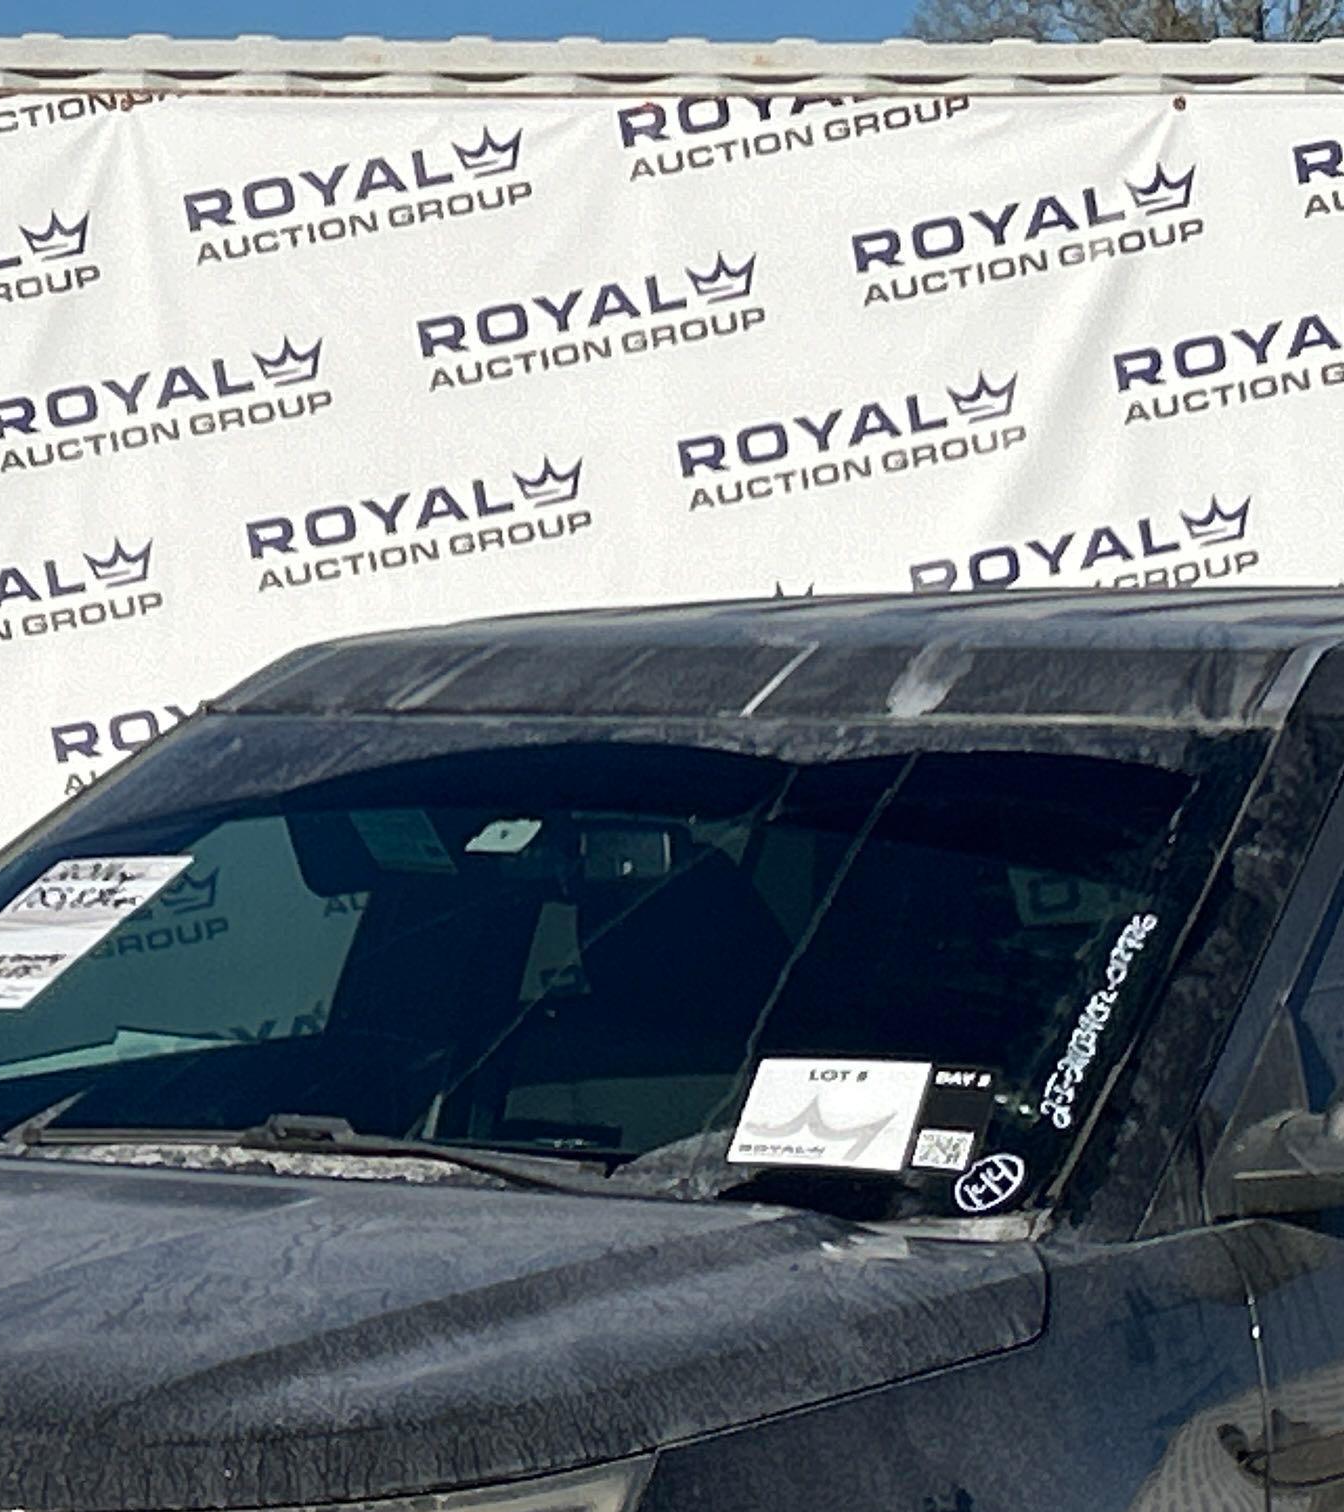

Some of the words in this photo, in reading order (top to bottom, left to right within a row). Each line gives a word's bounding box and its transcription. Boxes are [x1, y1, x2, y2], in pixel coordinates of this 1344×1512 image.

[629, 124, 815, 182] AUCTION
[824, 95, 971, 142] GROUP
[183, 148, 455, 233] ROYAL
[197, 210, 380, 267] AUCTION
[387, 181, 533, 229] GROUP
[851, 186, 1127, 274] ROYAL
[863, 249, 1049, 308] AUCTION
[1057, 218, 1204, 267] GROUP
[416, 274, 688, 360] ROYAL
[428, 335, 612, 393] AUCTION
[621, 307, 766, 354] GROUP
[0, 418, 181, 474] AUCTION
[189, 390, 333, 437] GROUP
[677, 393, 949, 479] ROYAL
[1124, 368, 1312, 426] AUCTION
[689, 455, 872, 512] AUCTION
[881, 425, 1027, 473] GROUP
[245, 479, 516, 560] ROYAL
[258, 538, 440, 593] AUCTION
[448, 510, 592, 556] GROUP
[910, 517, 1182, 592] ROYAL
[21, 592, 164, 637] GROUP
[808, 1068, 851, 1082] LOT
